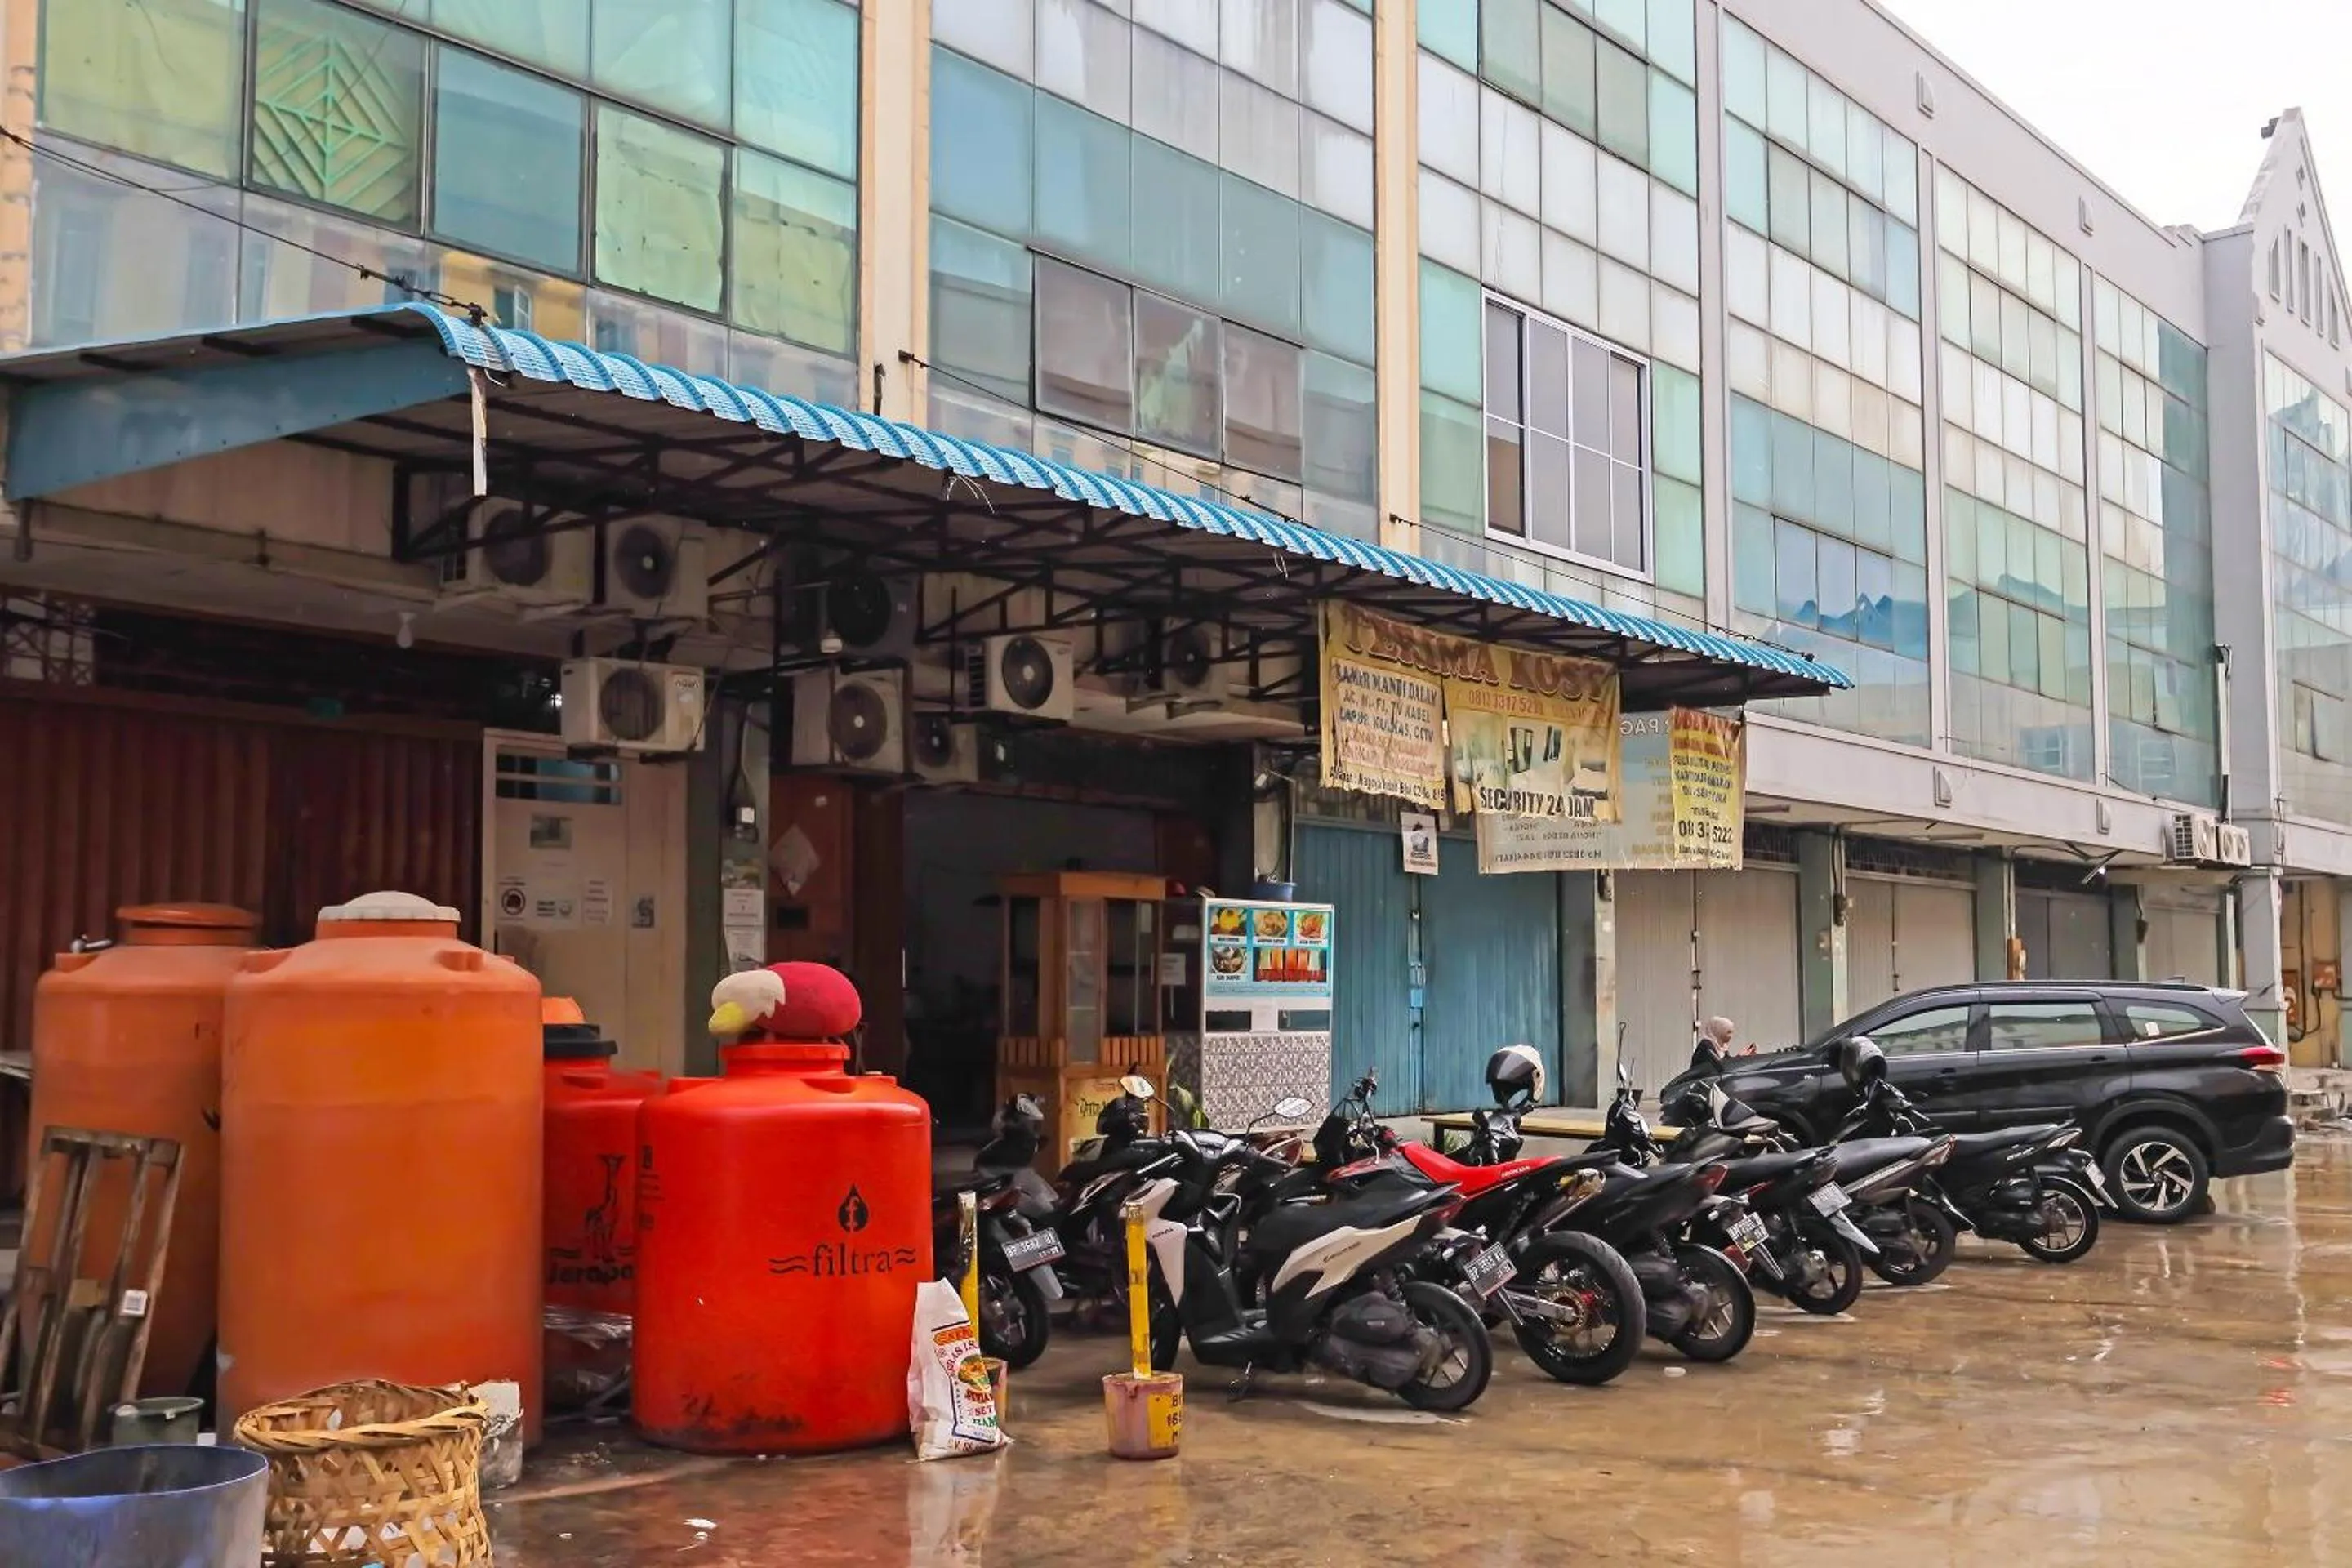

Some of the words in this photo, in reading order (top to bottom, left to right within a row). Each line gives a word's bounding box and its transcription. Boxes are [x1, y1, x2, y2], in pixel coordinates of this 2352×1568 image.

[1405, 703, 1430, 724] KABEL
[1480, 786, 1544, 815] SECURITY
[1547, 794, 1564, 816] 24
[1568, 795, 1595, 817] JAM
[813, 1243, 892, 1276] filtra
